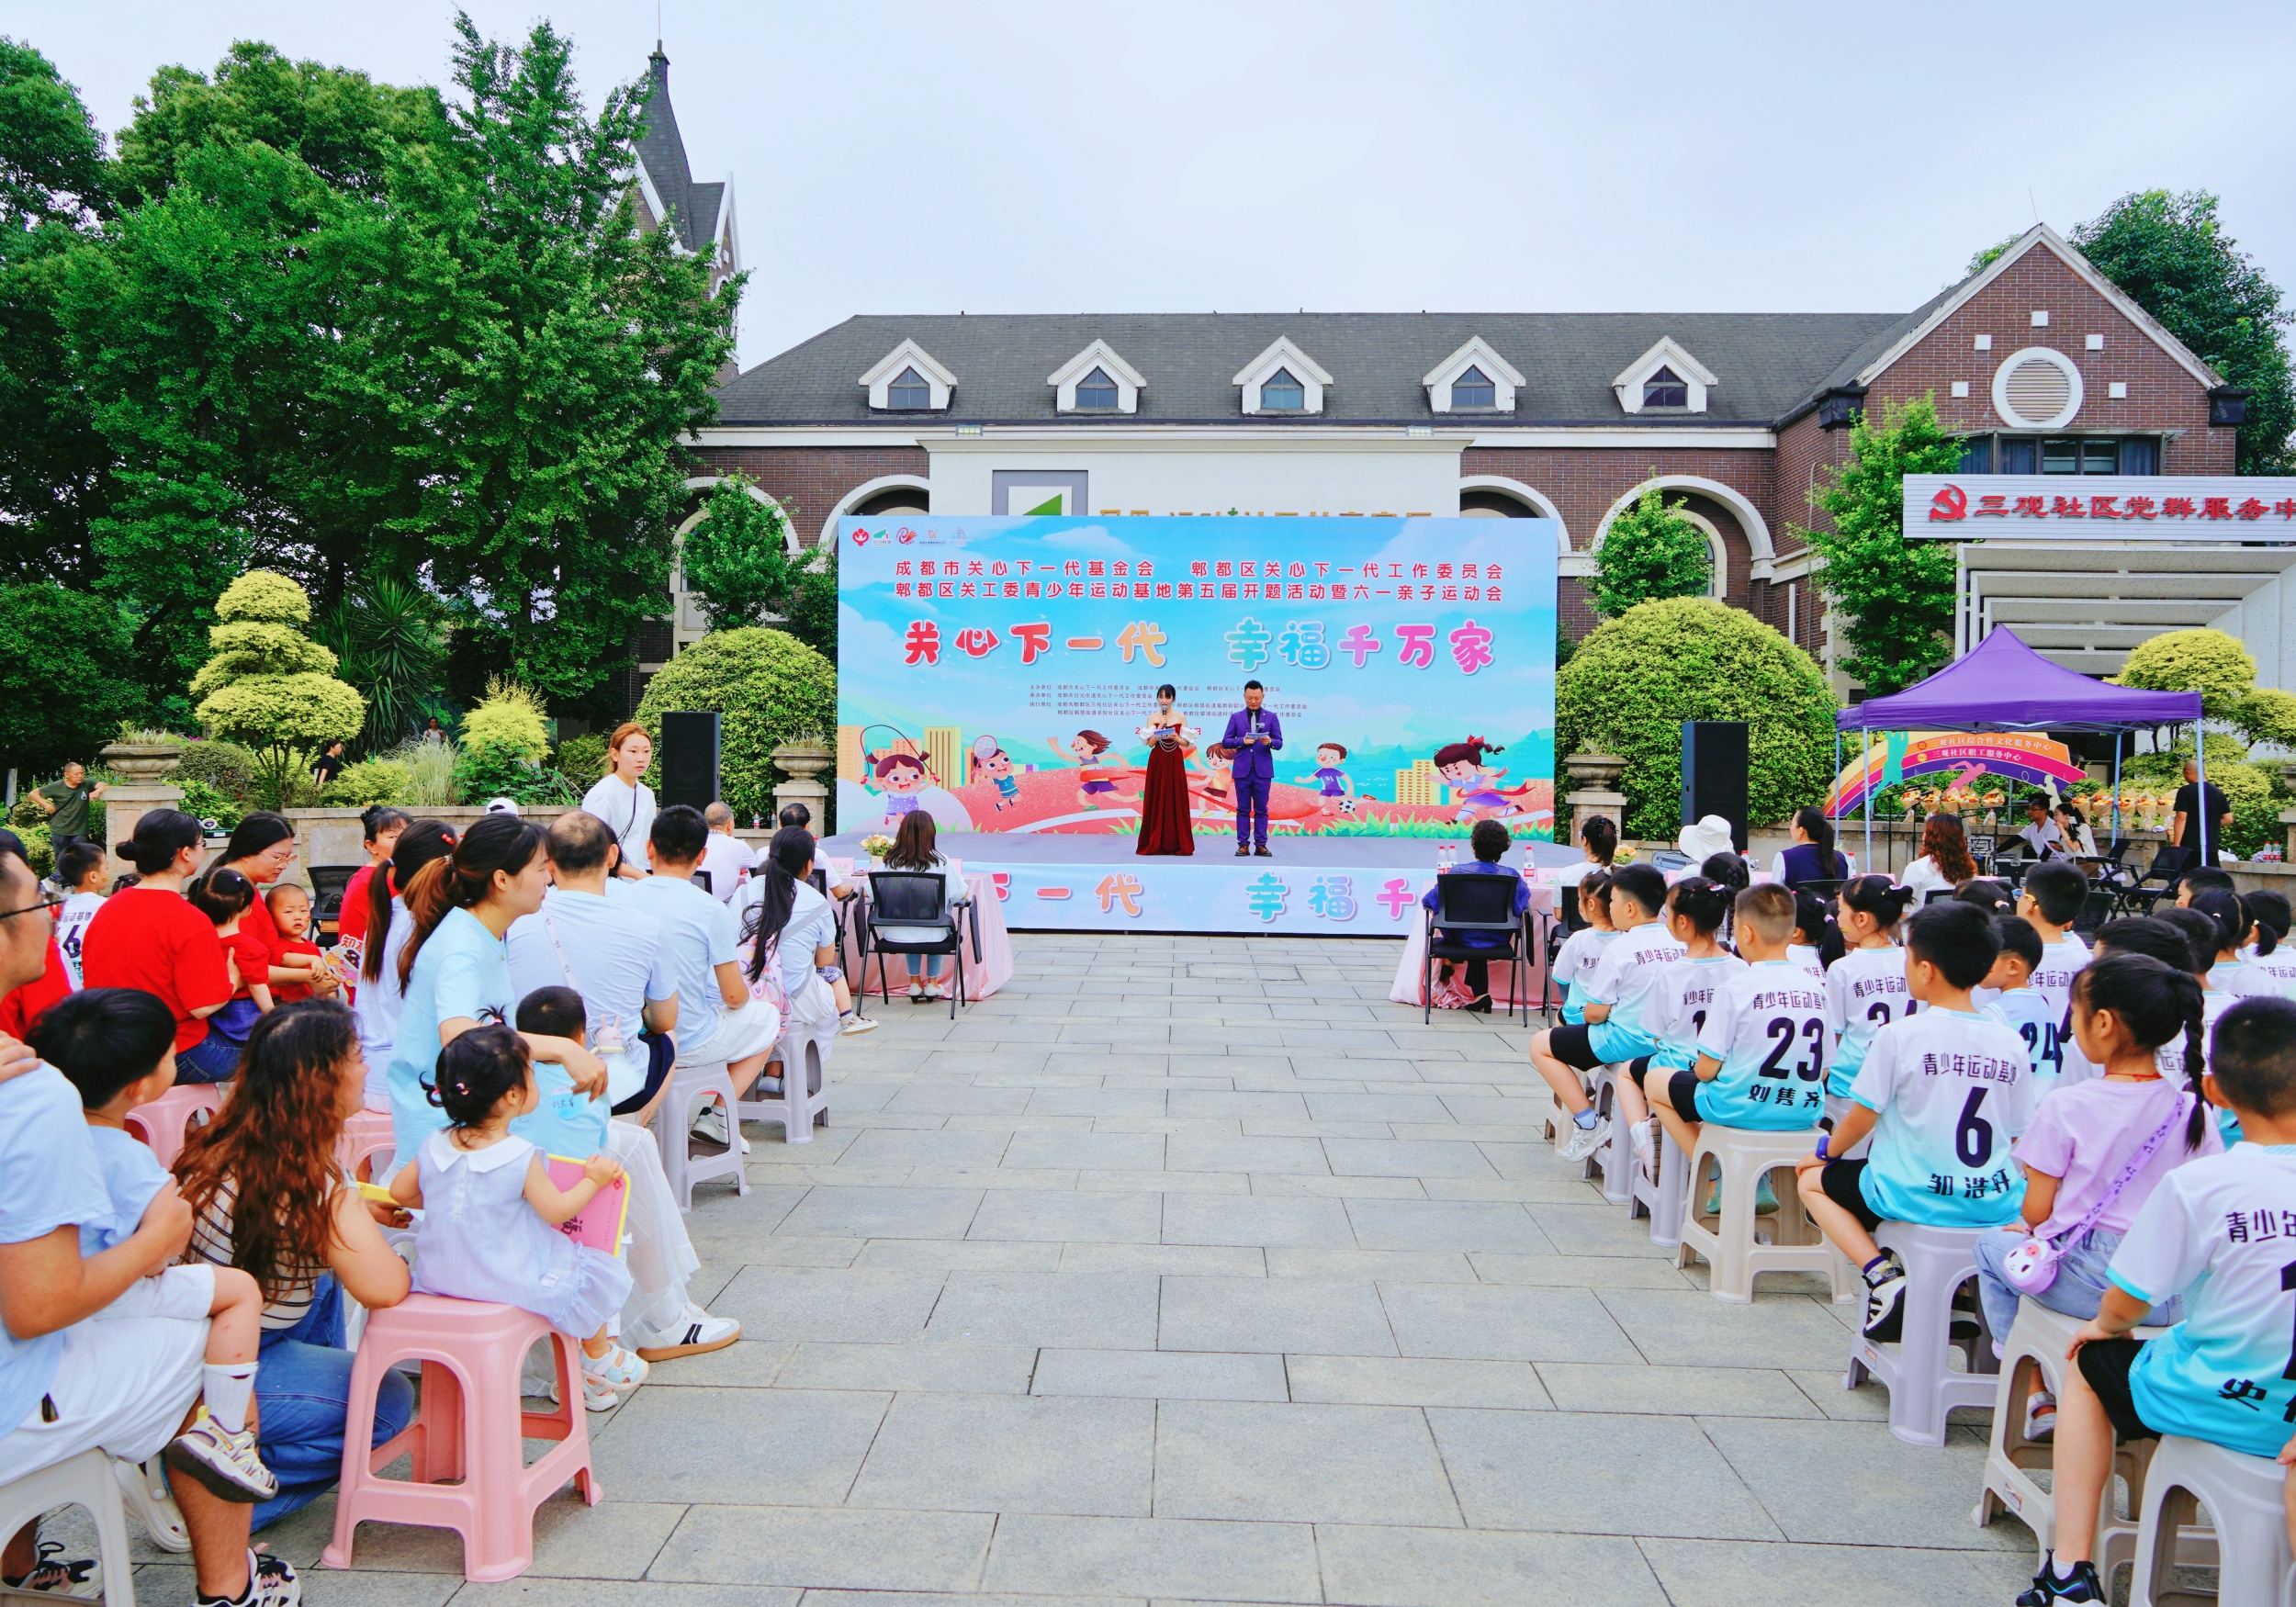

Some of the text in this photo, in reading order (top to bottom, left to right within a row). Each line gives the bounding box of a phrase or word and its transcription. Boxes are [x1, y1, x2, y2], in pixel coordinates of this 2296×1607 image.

[1975, 495, 2296, 521] 三观社区党群服务中
[895, 560, 1503, 580] 成都市关心下一代基金会 郫都区关心下一代工作委员会
[895, 581, 1504, 602] 郫都区关工委青少年运动基地第五届开题活动暨六一亲子运动会
[905, 616, 1495, 675] 关心下一代 幸福千万家
[1930, 736, 2052, 751] 三观社区综合性文化服务中心
[1932, 747, 2022, 761] 三观社区职工服务中心
[1244, 870, 1417, 923] 幸福千
[58, 911, 93, 923] 运动基地
[1758, 1017, 1825, 1082] 23
[1955, 1085, 1993, 1169] 6
